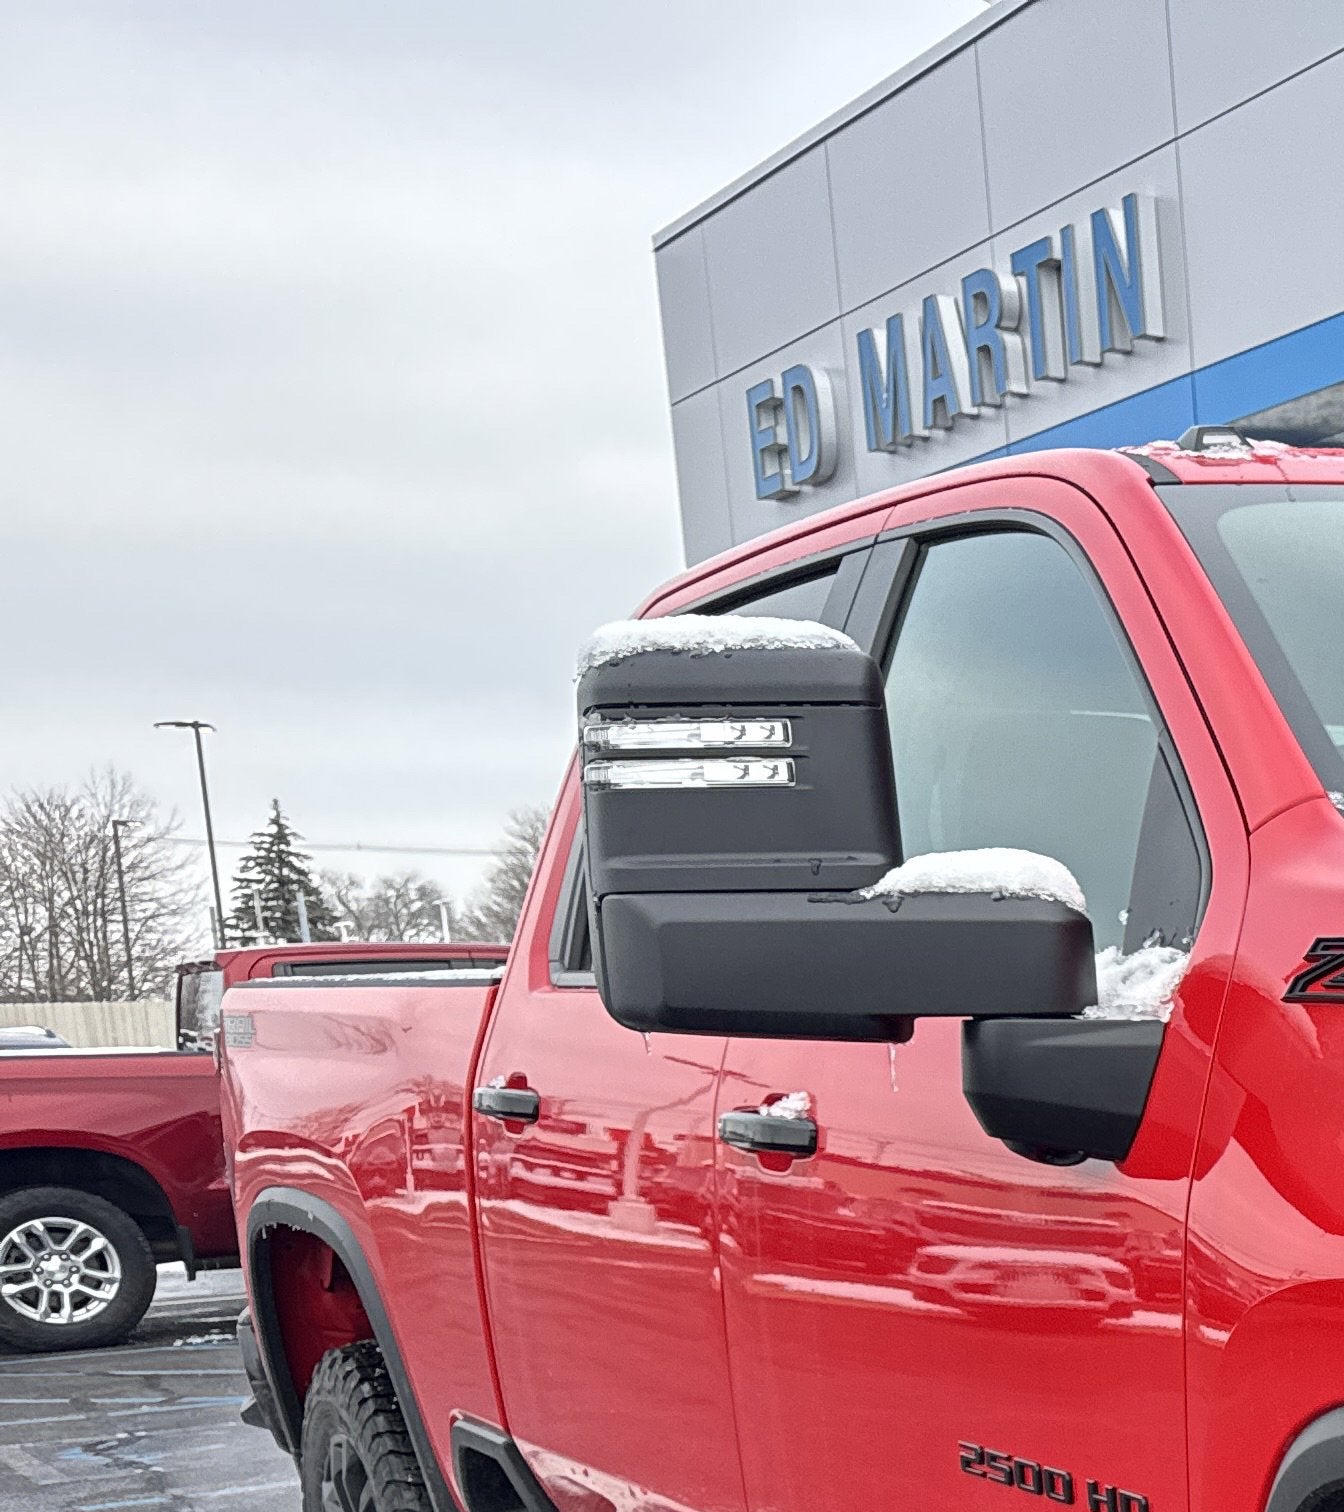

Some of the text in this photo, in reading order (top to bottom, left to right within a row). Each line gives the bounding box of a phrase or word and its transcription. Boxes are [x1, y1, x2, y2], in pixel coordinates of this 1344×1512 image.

[745, 192, 1164, 500] ED MARTIN
[957, 1439, 1076, 1505] 2500
